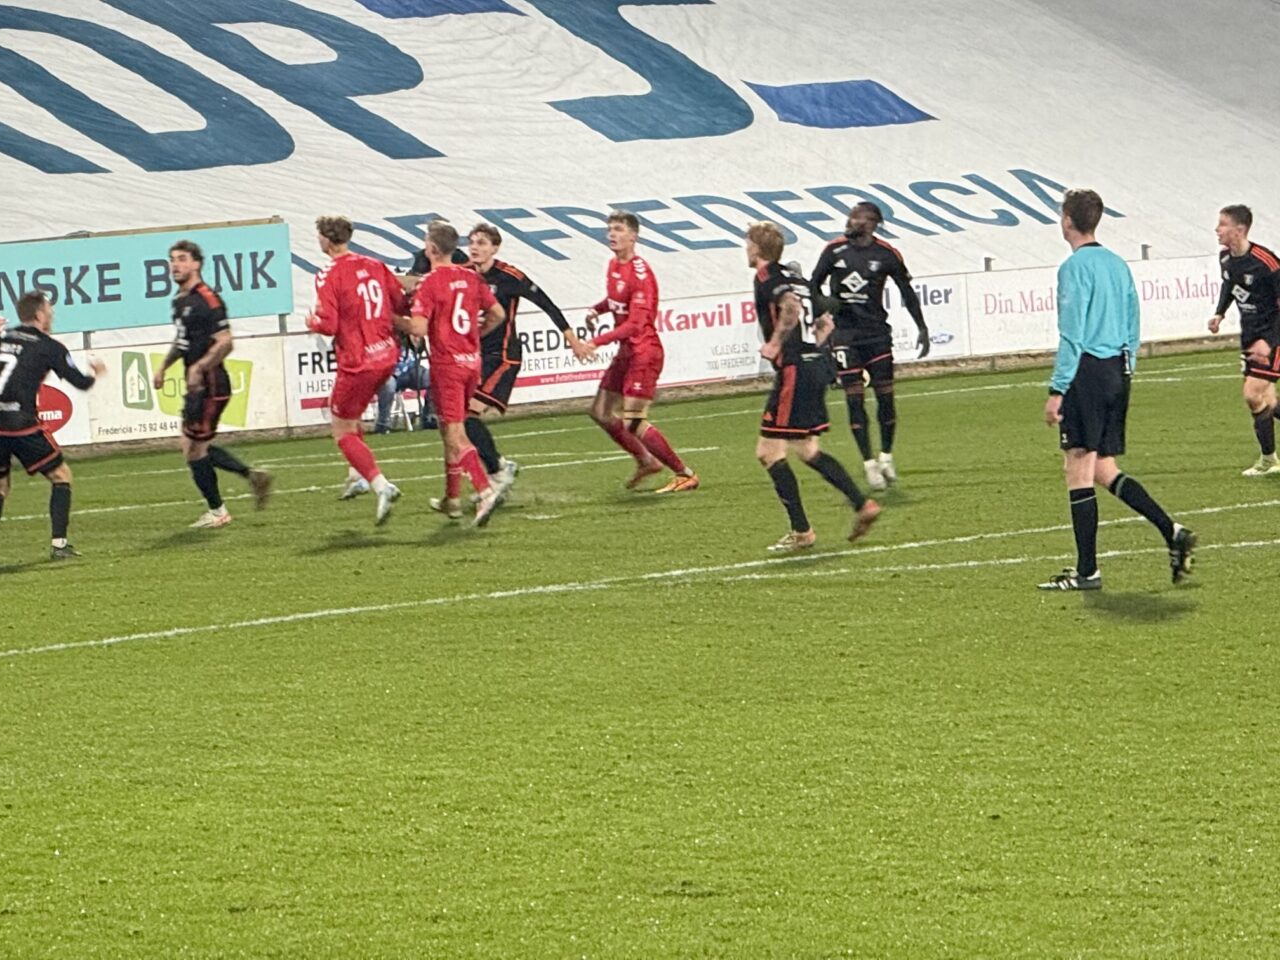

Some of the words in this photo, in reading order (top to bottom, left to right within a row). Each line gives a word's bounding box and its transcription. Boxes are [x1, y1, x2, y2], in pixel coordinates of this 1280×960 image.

[474, 168, 1126, 261] FREDERICIA
[144, 250, 277, 298] BNK
[1141, 279, 1171, 302] Din
[356, 279, 383, 321] 19
[451, 292, 471, 336] 6
[657, 303, 731, 333] Karvil
[984, 292, 1015, 315] Din
[98, 426, 133, 435] Fredericia
[138, 424, 148, 433] 75
[149, 424, 158, 432] 92
